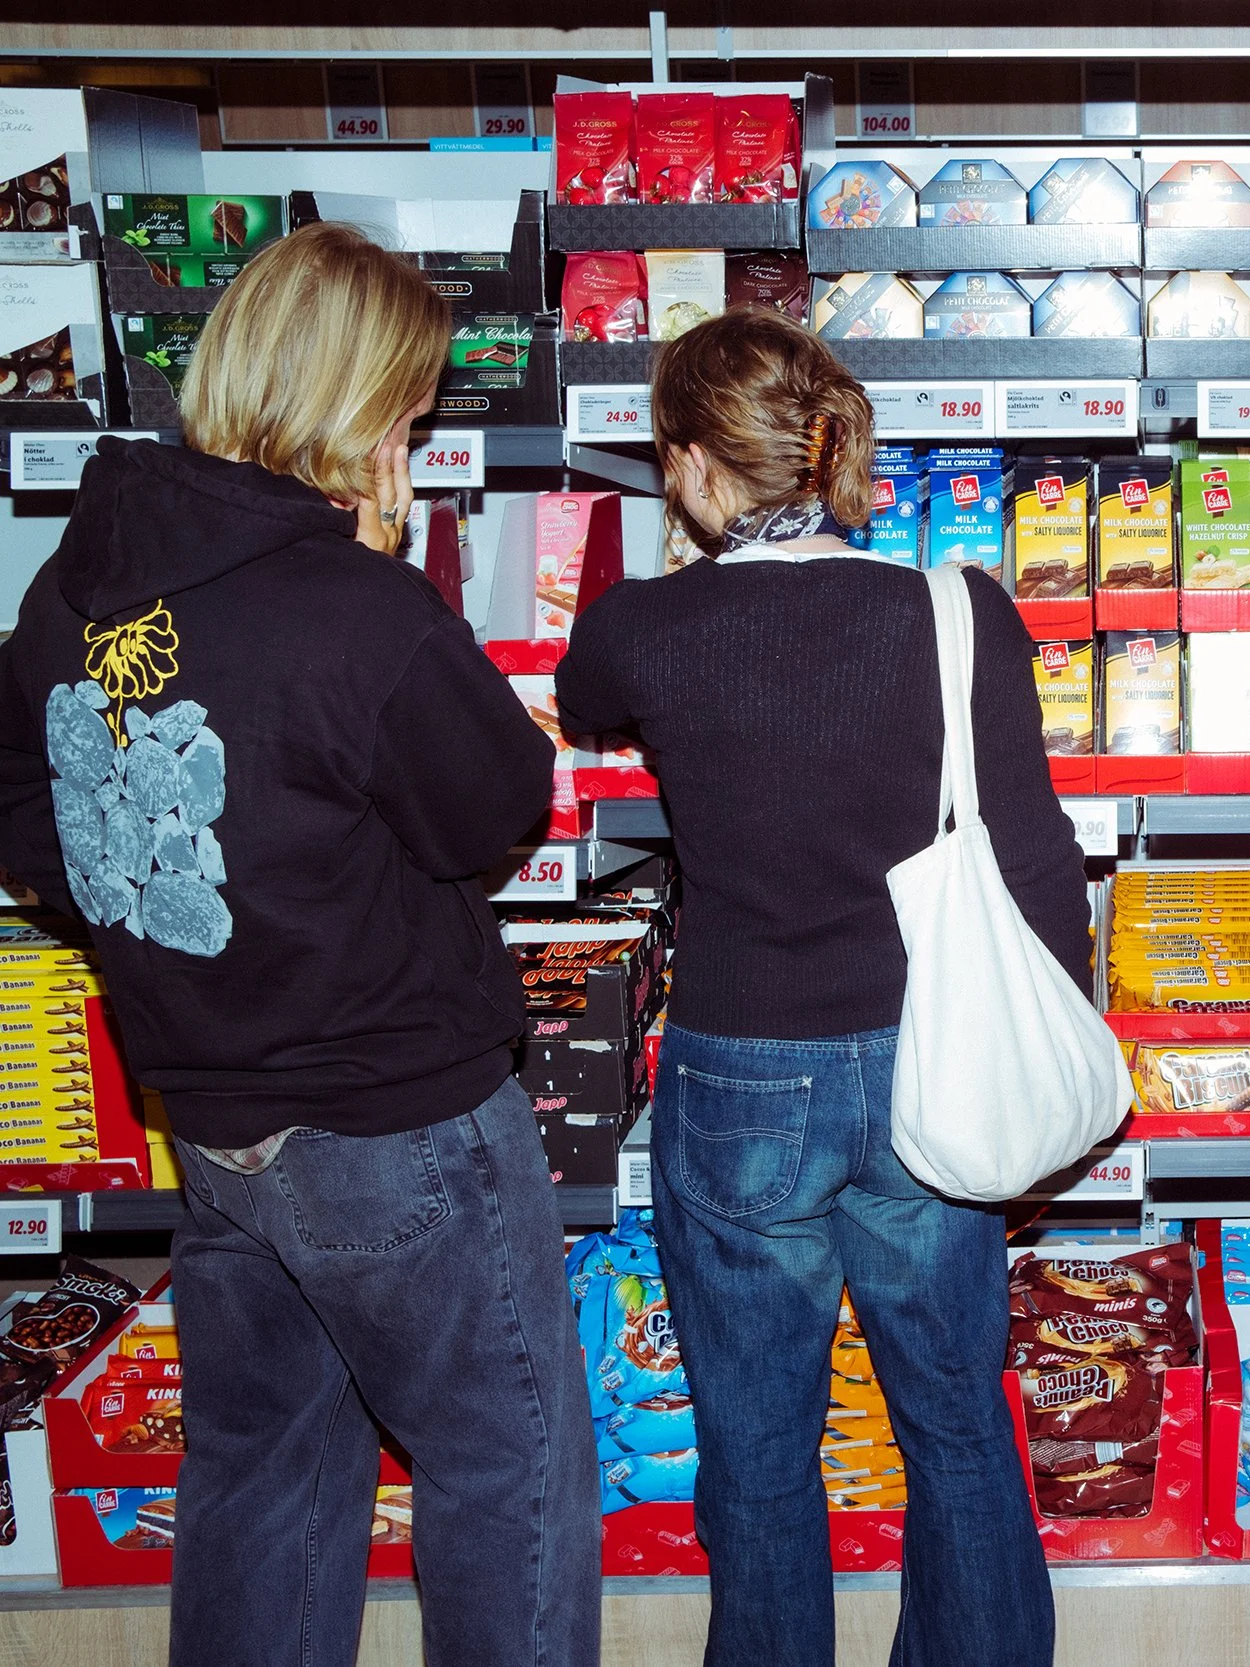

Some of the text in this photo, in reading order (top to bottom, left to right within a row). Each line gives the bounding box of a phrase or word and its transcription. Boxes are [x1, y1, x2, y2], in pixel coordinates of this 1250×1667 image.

[337, 120, 378, 135] 44.90
[486, 119, 525, 133] 29.90
[863, 117, 910, 131] 104.00
[451, 327, 480, 340] Mint
[940, 401, 982, 417] 18.90
[1083, 400, 1124, 416] 18.90
[606, 411, 638, 422] 24.90
[426, 451, 470, 466] 24.90
[955, 515, 978, 524] MILK
[1020, 516, 1083, 525] MILK CHOCOLATE
[940, 525, 993, 534] CHOCOLATE
[1035, 526, 1082, 536] SALTY LIQUORICE
[1189, 533, 1225, 541] HAZELNUT
[519, 861, 563, 883] 8.50
[9, 953, 41, 962] Bananas
[2, 1022, 33, 1032] Bananas
[534, 1020, 569, 1036] Japp
[547, 1080, 553, 1090] 1
[533, 1096, 567, 1111] Japp
[14, 1136, 46, 1147] Bananas
[1089, 1166, 1130, 1181] 44.90
[8, 1220, 47, 1236] 12.90
[1093, 1297, 1137, 1313] minis
[1143, 1316, 1162, 1324] 350g
